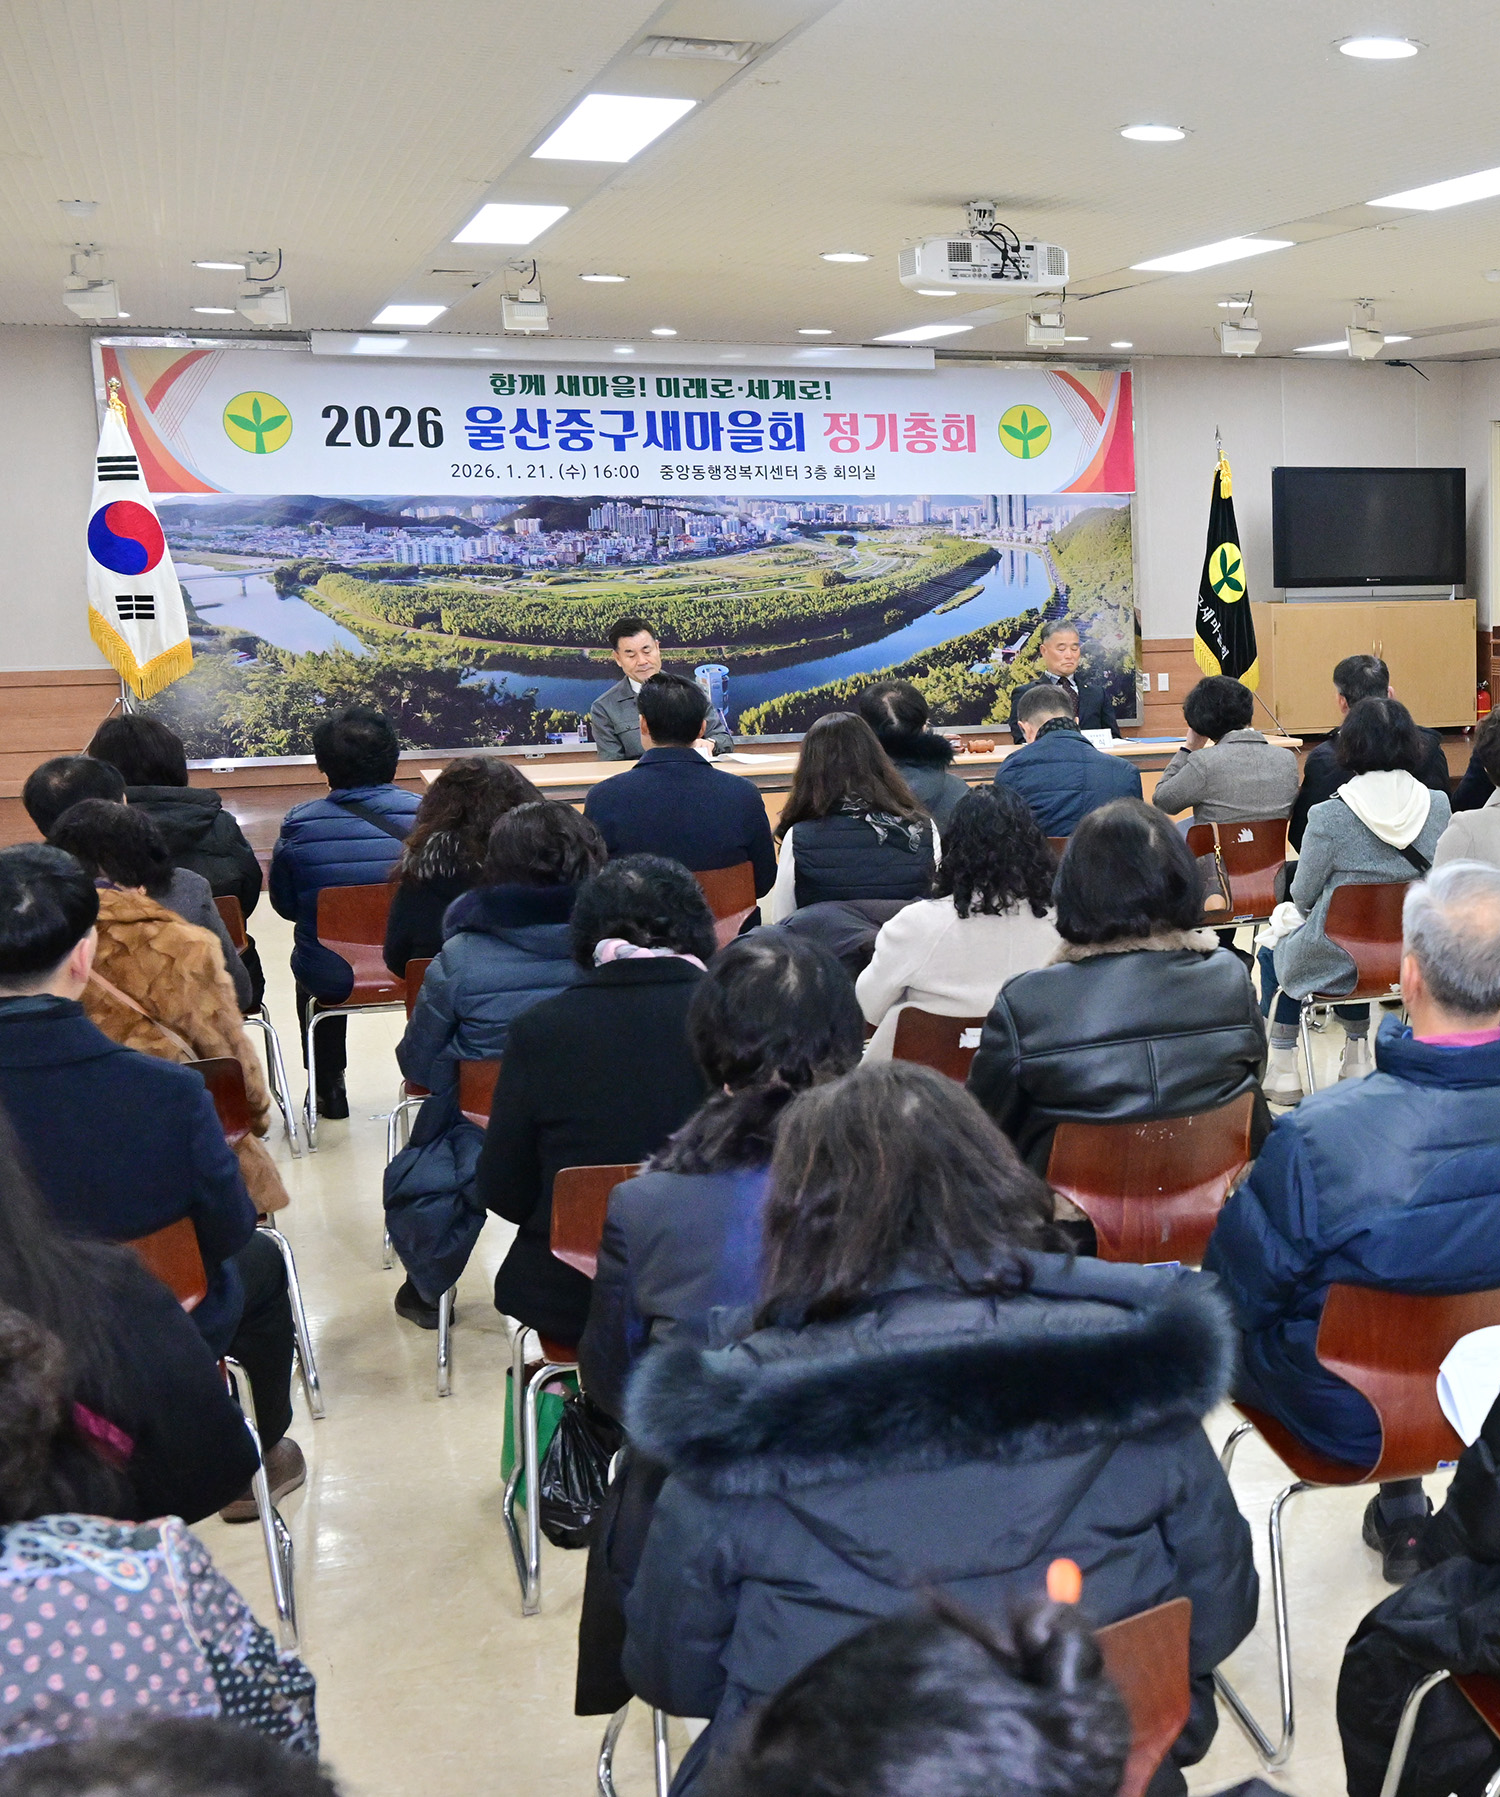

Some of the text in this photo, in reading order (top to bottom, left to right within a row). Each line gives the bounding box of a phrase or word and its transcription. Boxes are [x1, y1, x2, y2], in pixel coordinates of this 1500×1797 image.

[489, 373, 832, 401] 함께 새마을! 미래로·세계로!
[322, 404, 977, 454] 2026 울산중구새마을회 정기총회
[450, 463, 501, 479] 2026.
[558, 463, 587, 480] (수)
[593, 464, 640, 479] 16:00
[659, 464, 799, 481] 중앙동행정복지센터
[803, 465, 828, 480] 3층
[833, 465, 876, 480] 회의실
